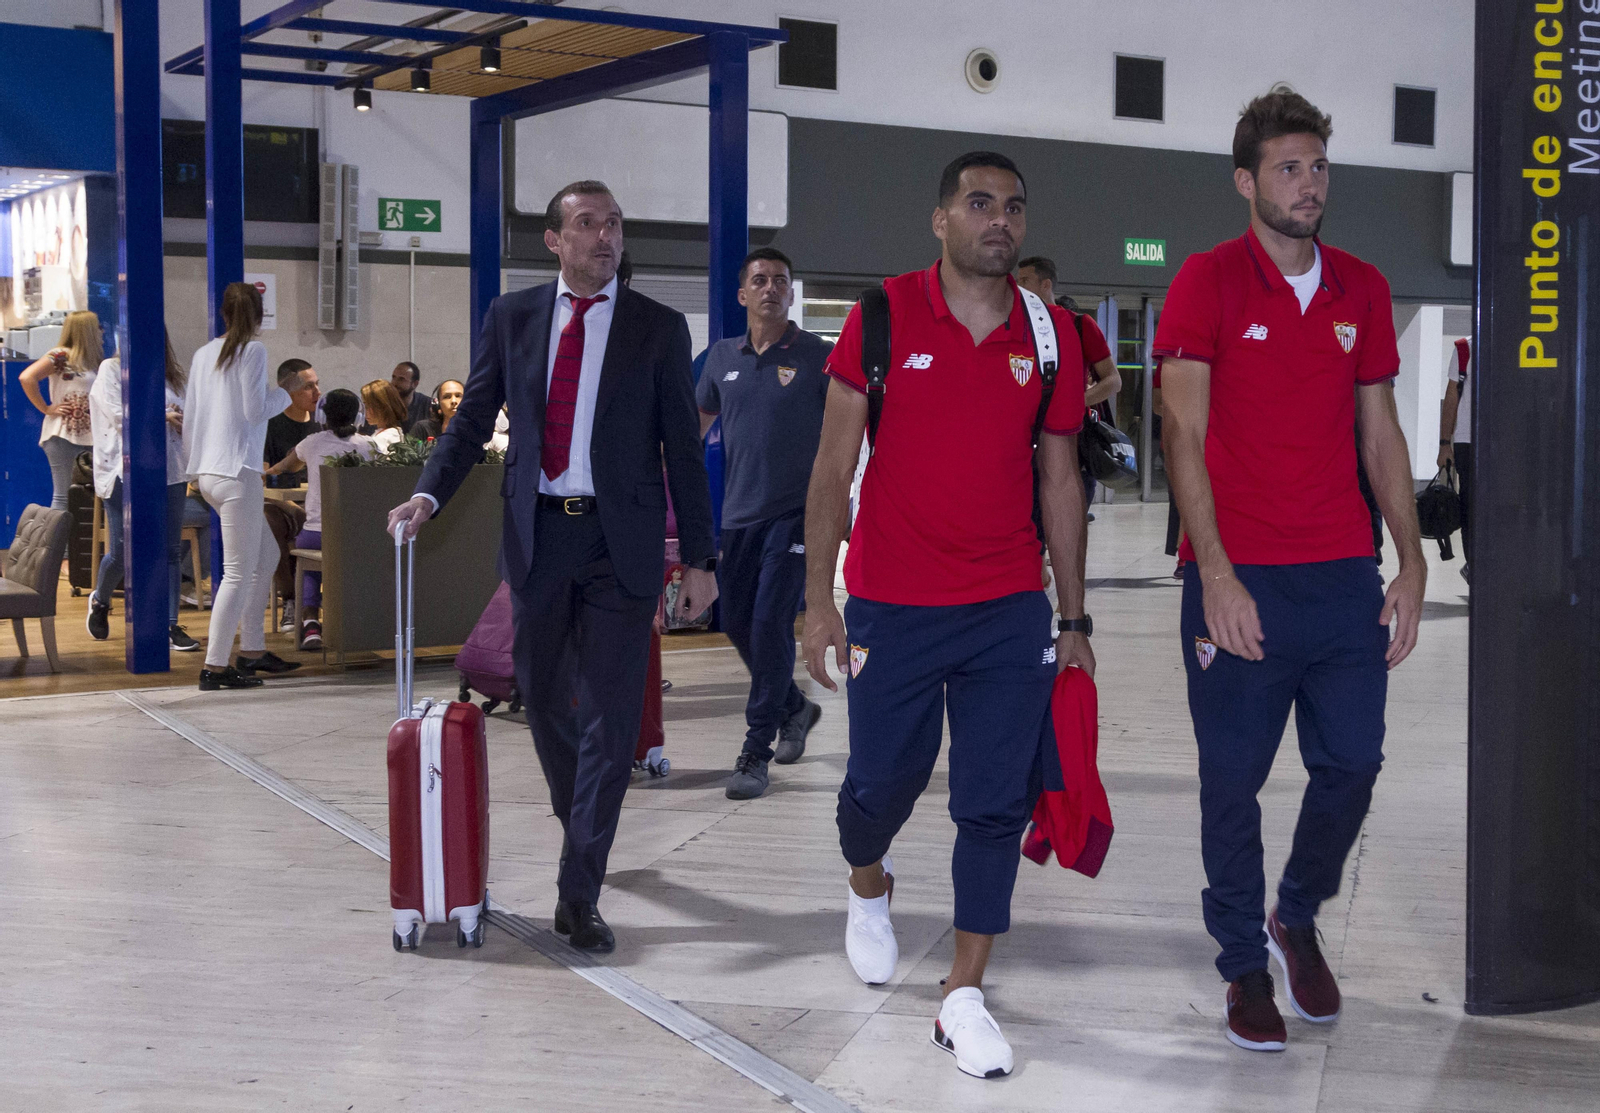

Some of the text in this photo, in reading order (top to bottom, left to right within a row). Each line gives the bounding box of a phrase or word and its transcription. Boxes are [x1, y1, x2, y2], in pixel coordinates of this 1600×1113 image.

[1522, 135, 1562, 198] de
[1126, 242, 1164, 262] SALIDA
[1519, 220, 1560, 368] Punto
